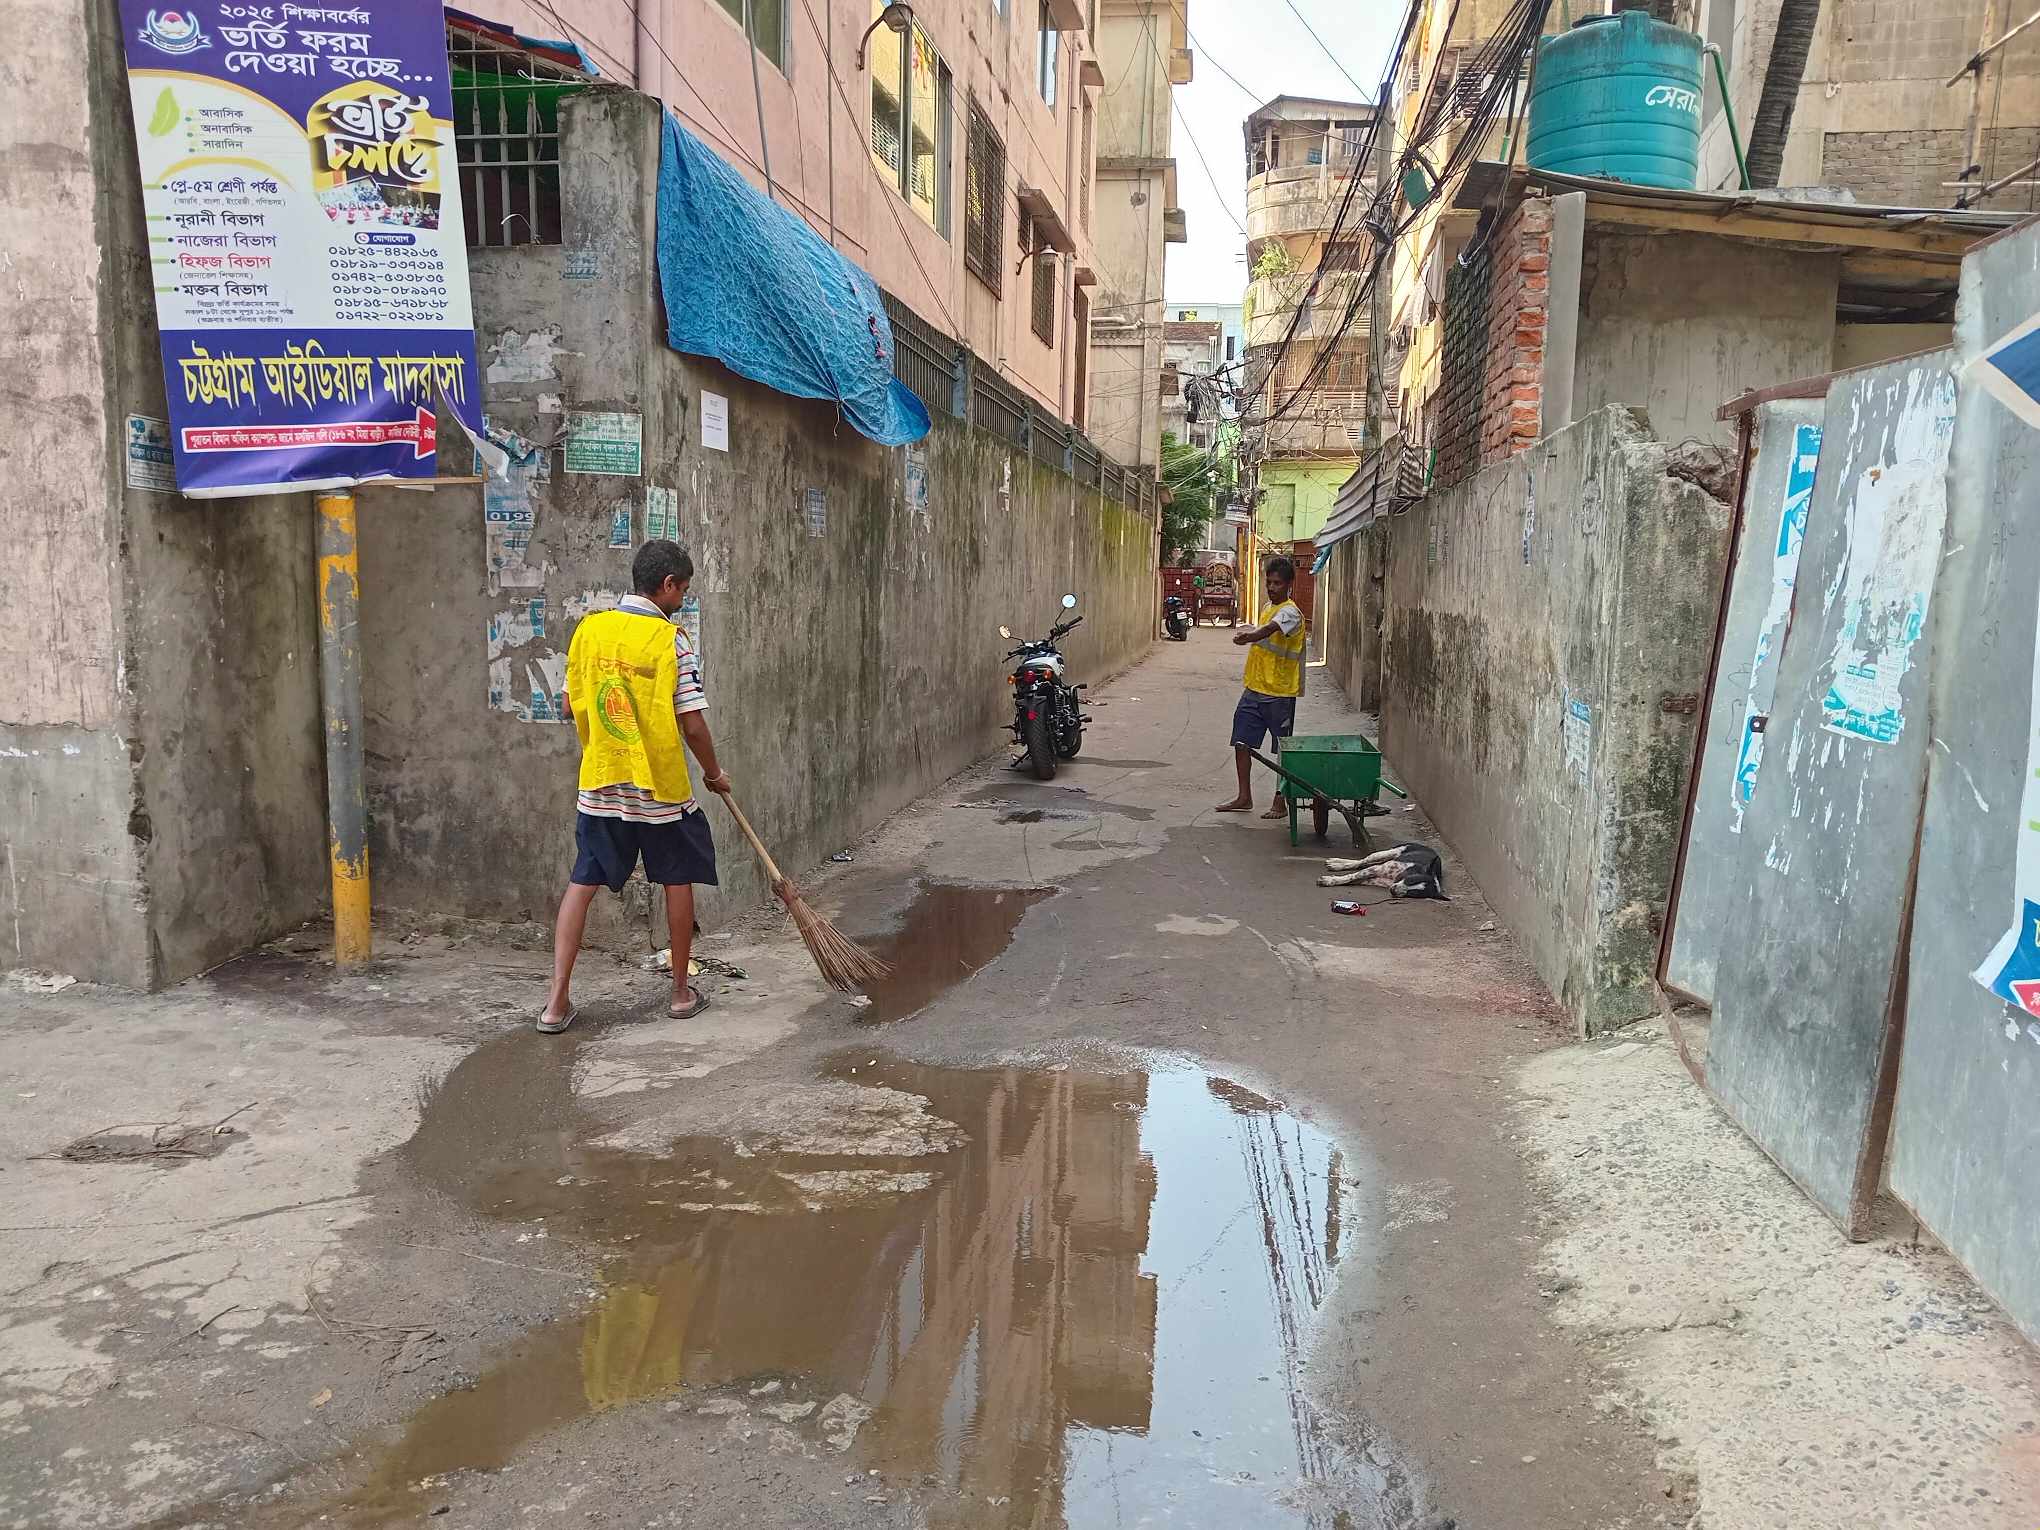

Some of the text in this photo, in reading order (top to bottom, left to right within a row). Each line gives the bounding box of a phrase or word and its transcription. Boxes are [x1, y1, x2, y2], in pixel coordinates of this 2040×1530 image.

[219, 3, 371, 24] ২০২৫ শিক্ষাবর্ষের
[217, 20, 290, 50] ভর্তি
[296, 30, 372, 55] ফরম
[225, 51, 319, 77] দেওয়া
[199, 107, 244, 118] আবাসিক
[200, 123, 253, 134] অনাবাসিক
[203, 138, 244, 149] সারাদিন
[217, 177, 246, 193] শ্রেণী
[250, 178, 278, 194] পর্যন্ত
[173, 210, 265, 230] নূরানী বিভাগ
[176, 232, 277, 248] নাজেরা বিভাগ
[329, 246, 438, 257] ০১৮২৫-৪৪২১৬৫
[227, 252, 272, 268] বিভাগ
[330, 260, 444, 270] ০১৮১৯-৩৩৭৩১৪
[331, 273, 444, 282] ০১৭৪২-৫৩৩৮৩৫
[182, 280, 269, 296] মক্তব বিভাগ
[334, 299, 448, 308] ০১৮১৫-৬৭১৮৬৮
[336, 311, 444, 321] ০১৭২২-০২২৩৮১
[178, 339, 257, 410] চট্টগ্রাম
[259, 338, 373, 412] আইডিয়াল
